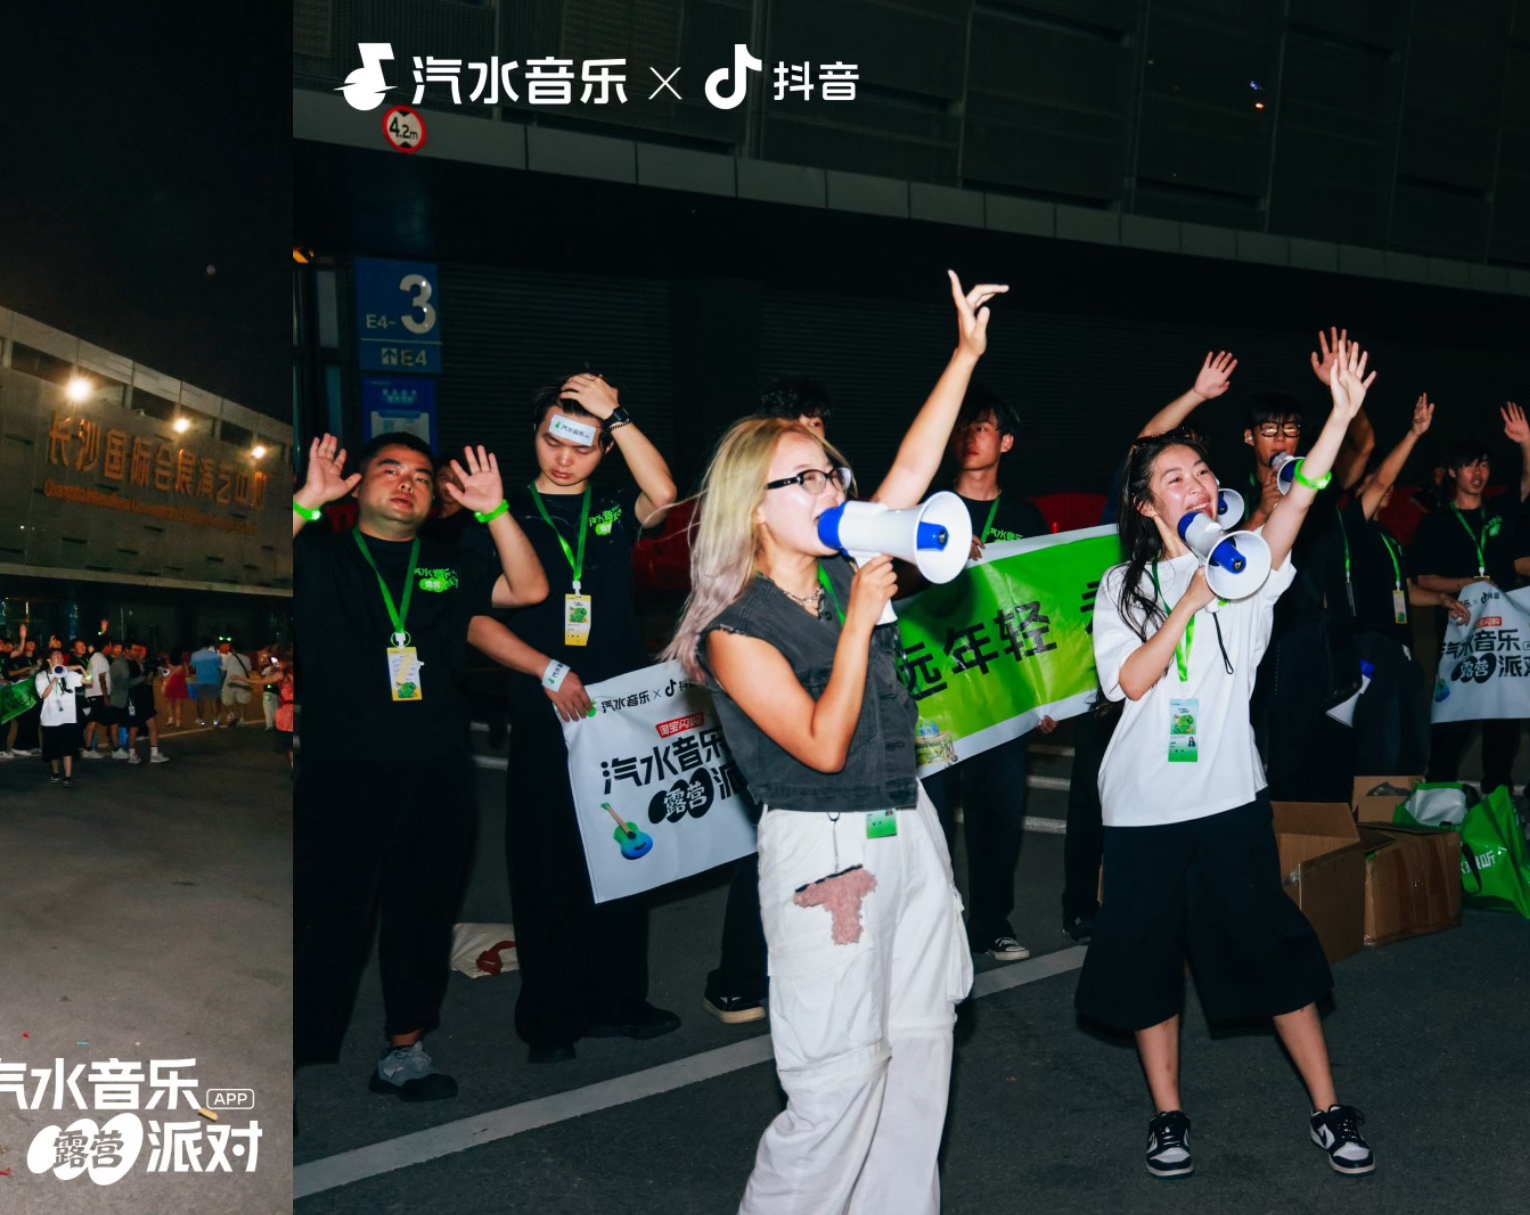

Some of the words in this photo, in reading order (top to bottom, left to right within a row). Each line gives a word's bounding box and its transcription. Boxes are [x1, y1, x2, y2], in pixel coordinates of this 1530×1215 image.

[389, 116, 419, 140] 4.2m
[401, 349, 428, 367] E4
[599, 689, 651, 714] 汽水音乐
